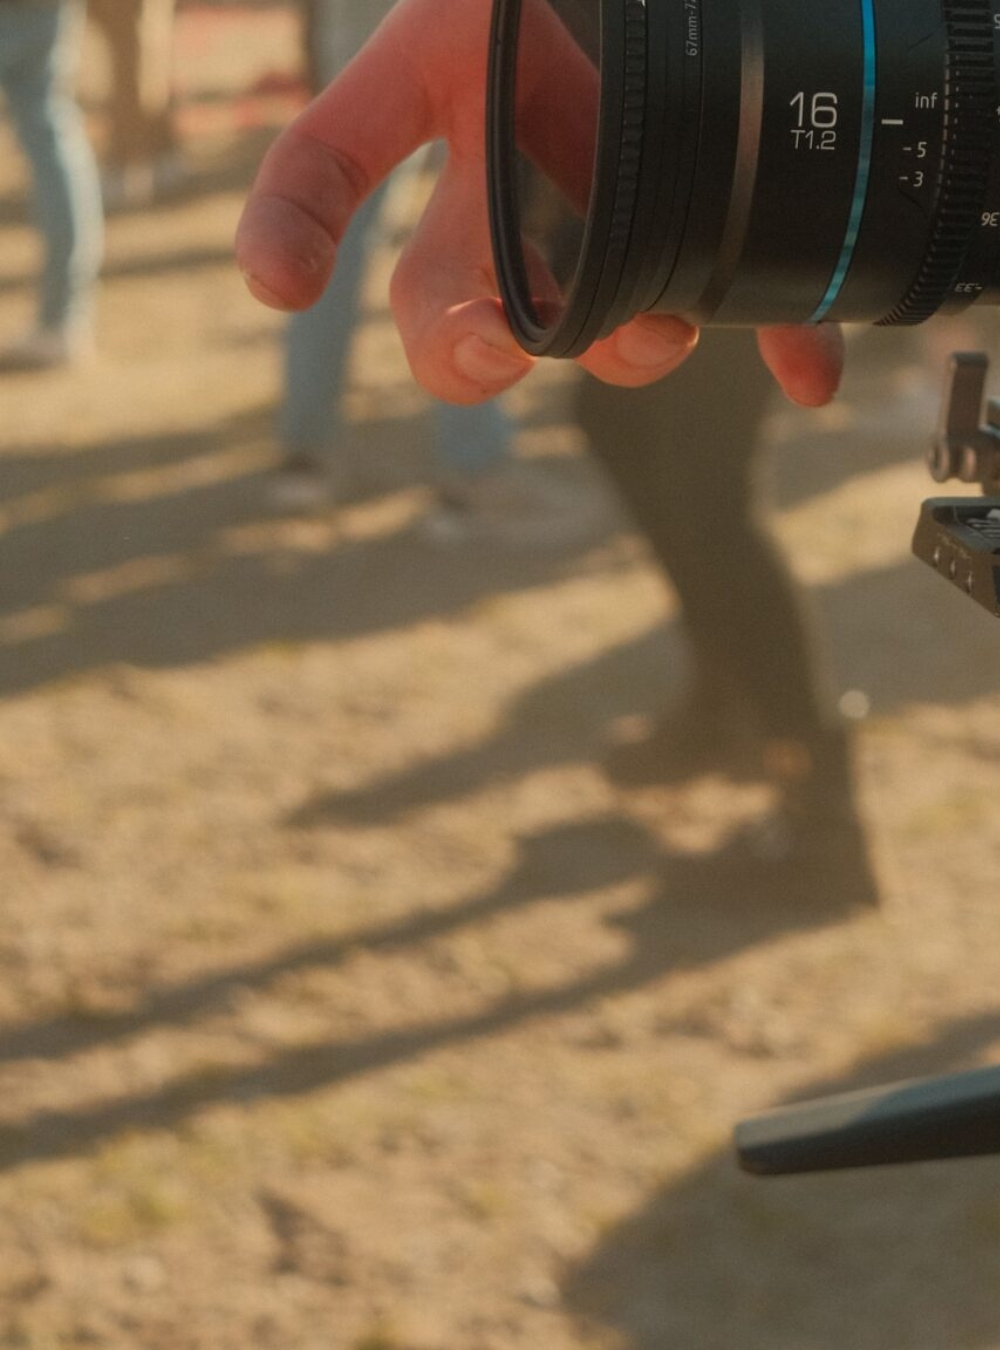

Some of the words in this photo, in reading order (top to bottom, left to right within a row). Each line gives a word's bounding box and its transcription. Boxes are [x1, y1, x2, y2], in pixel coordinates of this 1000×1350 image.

[914, 92, 938, 109] inf
[789, 91, 838, 128] 16
[790, 129, 837, 150] T1.2
[917, 141, 928, 158] 5
[913, 171, 924, 187] 3
